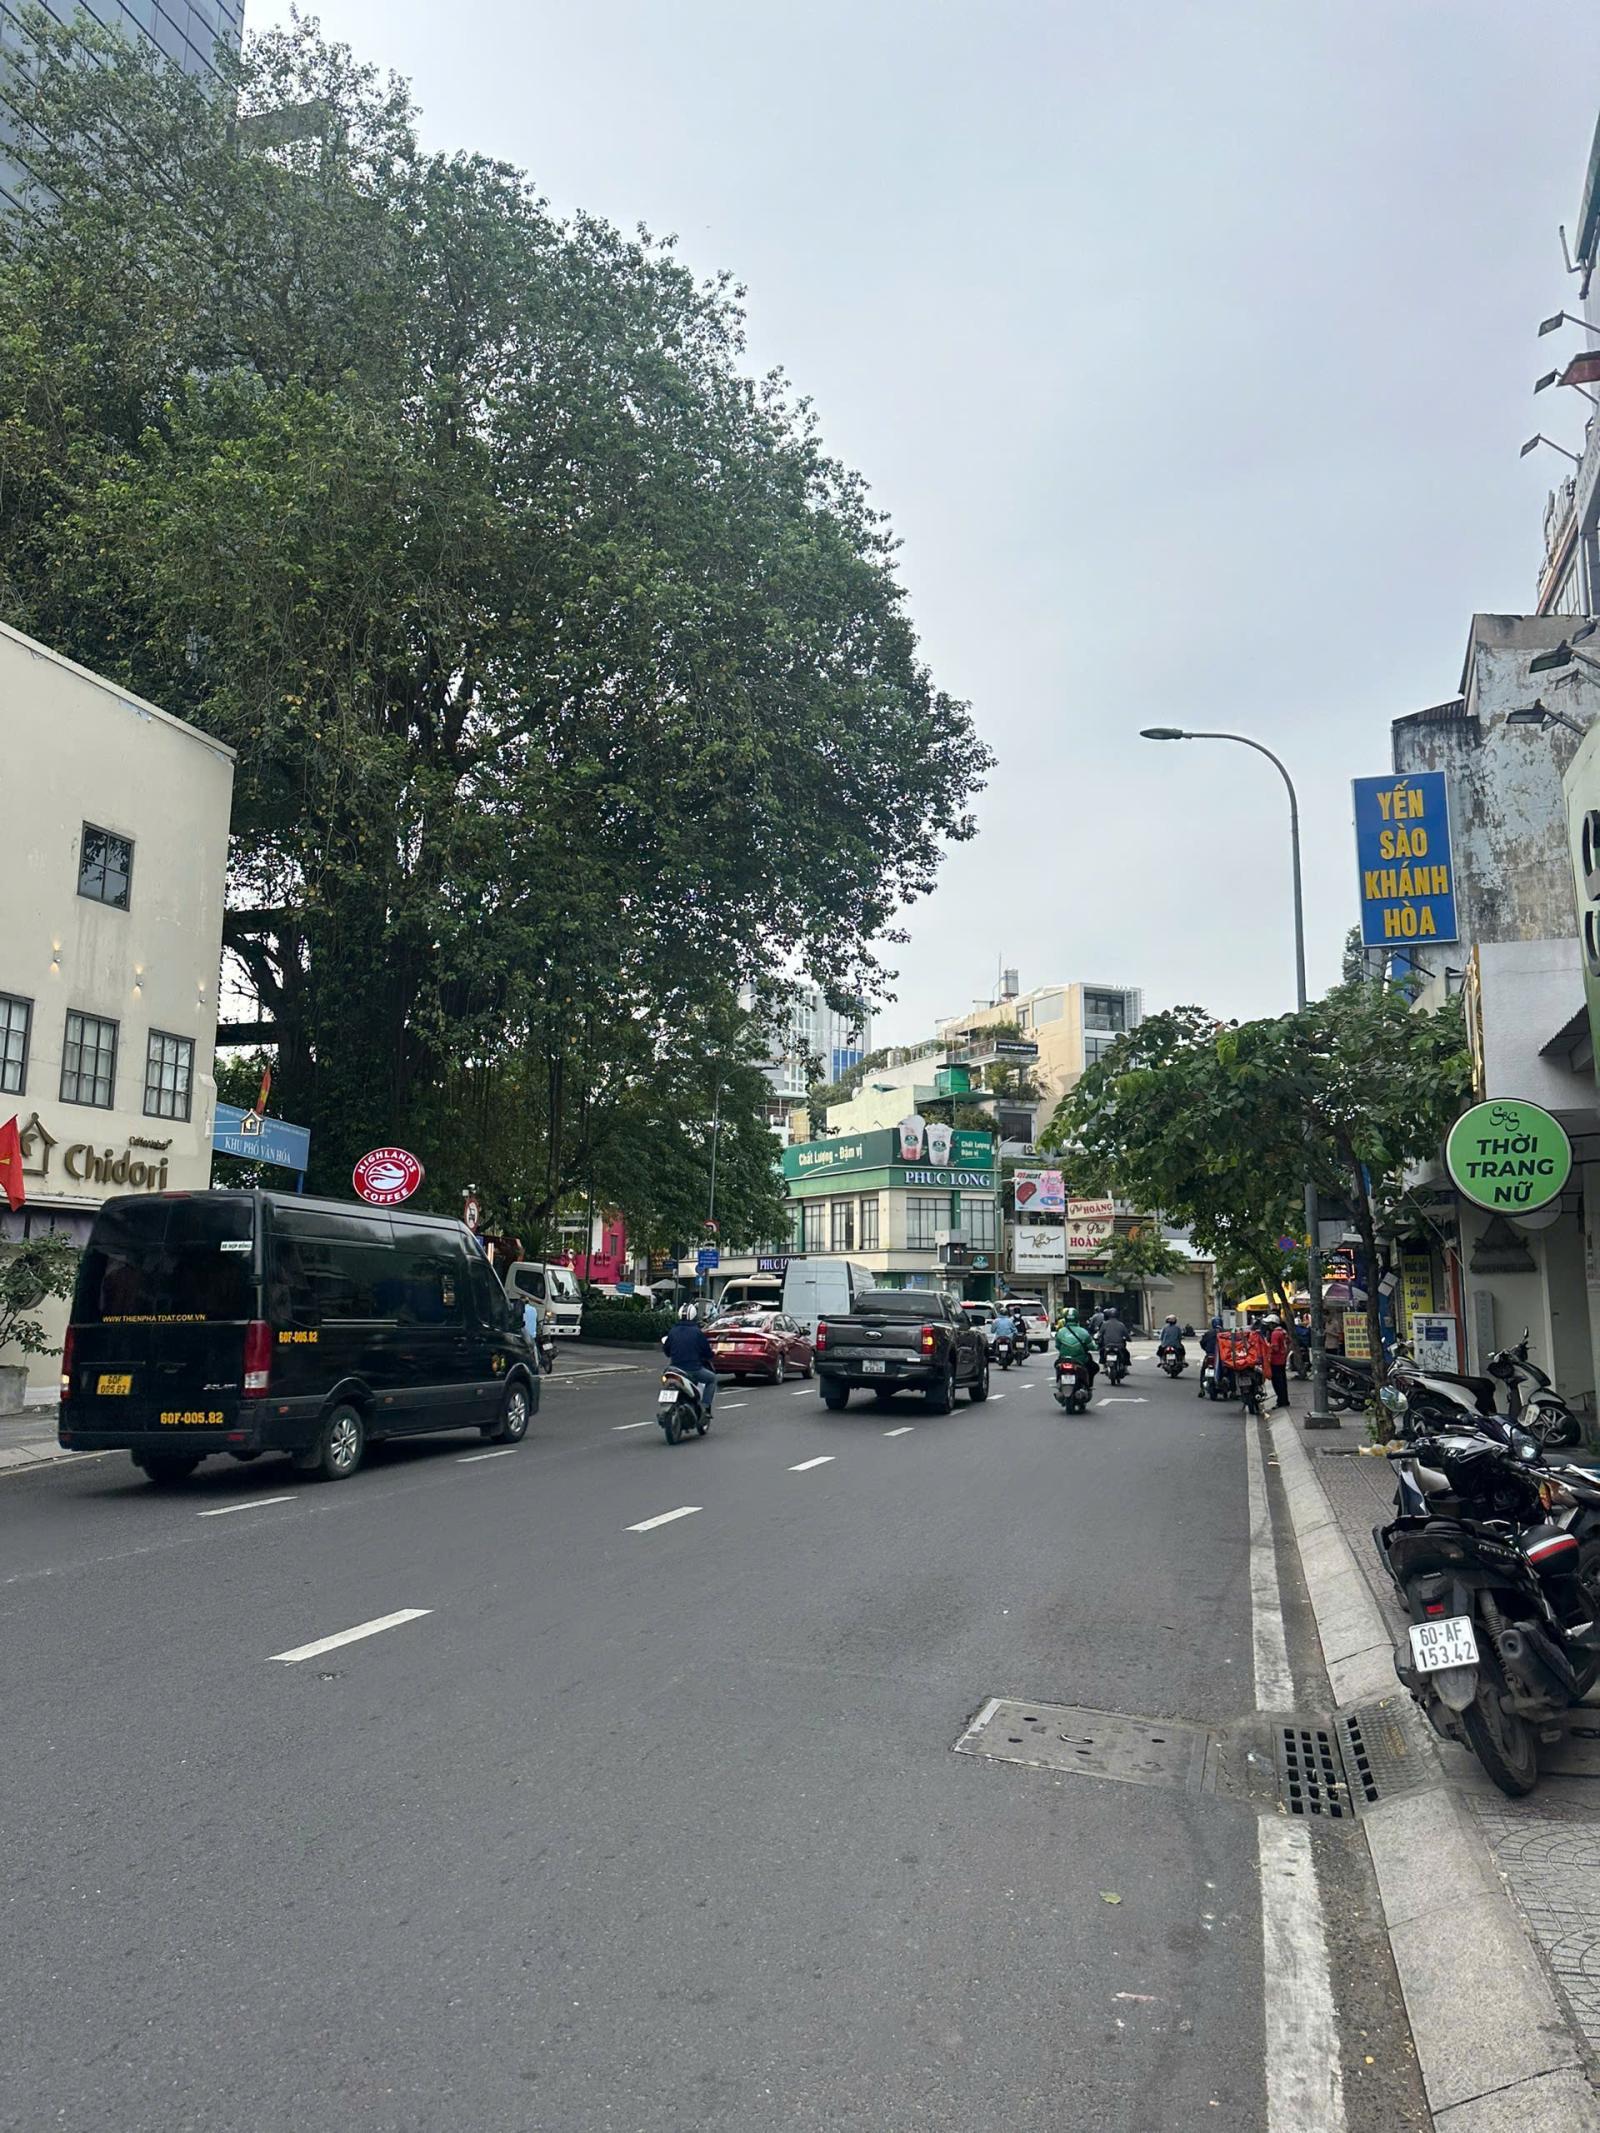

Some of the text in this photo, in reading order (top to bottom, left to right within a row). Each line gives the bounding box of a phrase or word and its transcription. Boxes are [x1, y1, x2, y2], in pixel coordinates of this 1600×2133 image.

[1376, 779, 1424, 820] YẾN
[1379, 823, 1428, 860] SÀO
[1364, 861, 1449, 900] KHÁNH
[1383, 900, 1437, 938] HÒA
[1489, 1106, 1520, 1132] S&S
[225, 1136, 291, 1164] KHU PHỐ VĂN HÓA
[1477, 1133, 1538, 1155] THỜI
[65, 1144, 169, 1190] Chidori
[358, 1149, 417, 1174] HIGHLANDS
[1466, 1158, 1554, 1178] TRANG
[950, 1172, 990, 1186] LONG
[363, 1187, 409, 1202] COFFEE
[1494, 1181, 1534, 1203] NỮ
[1083, 1202, 1113, 1214] HOÀNG
[1070, 1235, 1101, 1247] HOÀN
[160, 1411, 224, 1425] 60F-005.82
[1419, 1621, 1462, 1647] 60-AF
[1418, 1641, 1475, 1669] 153.42
